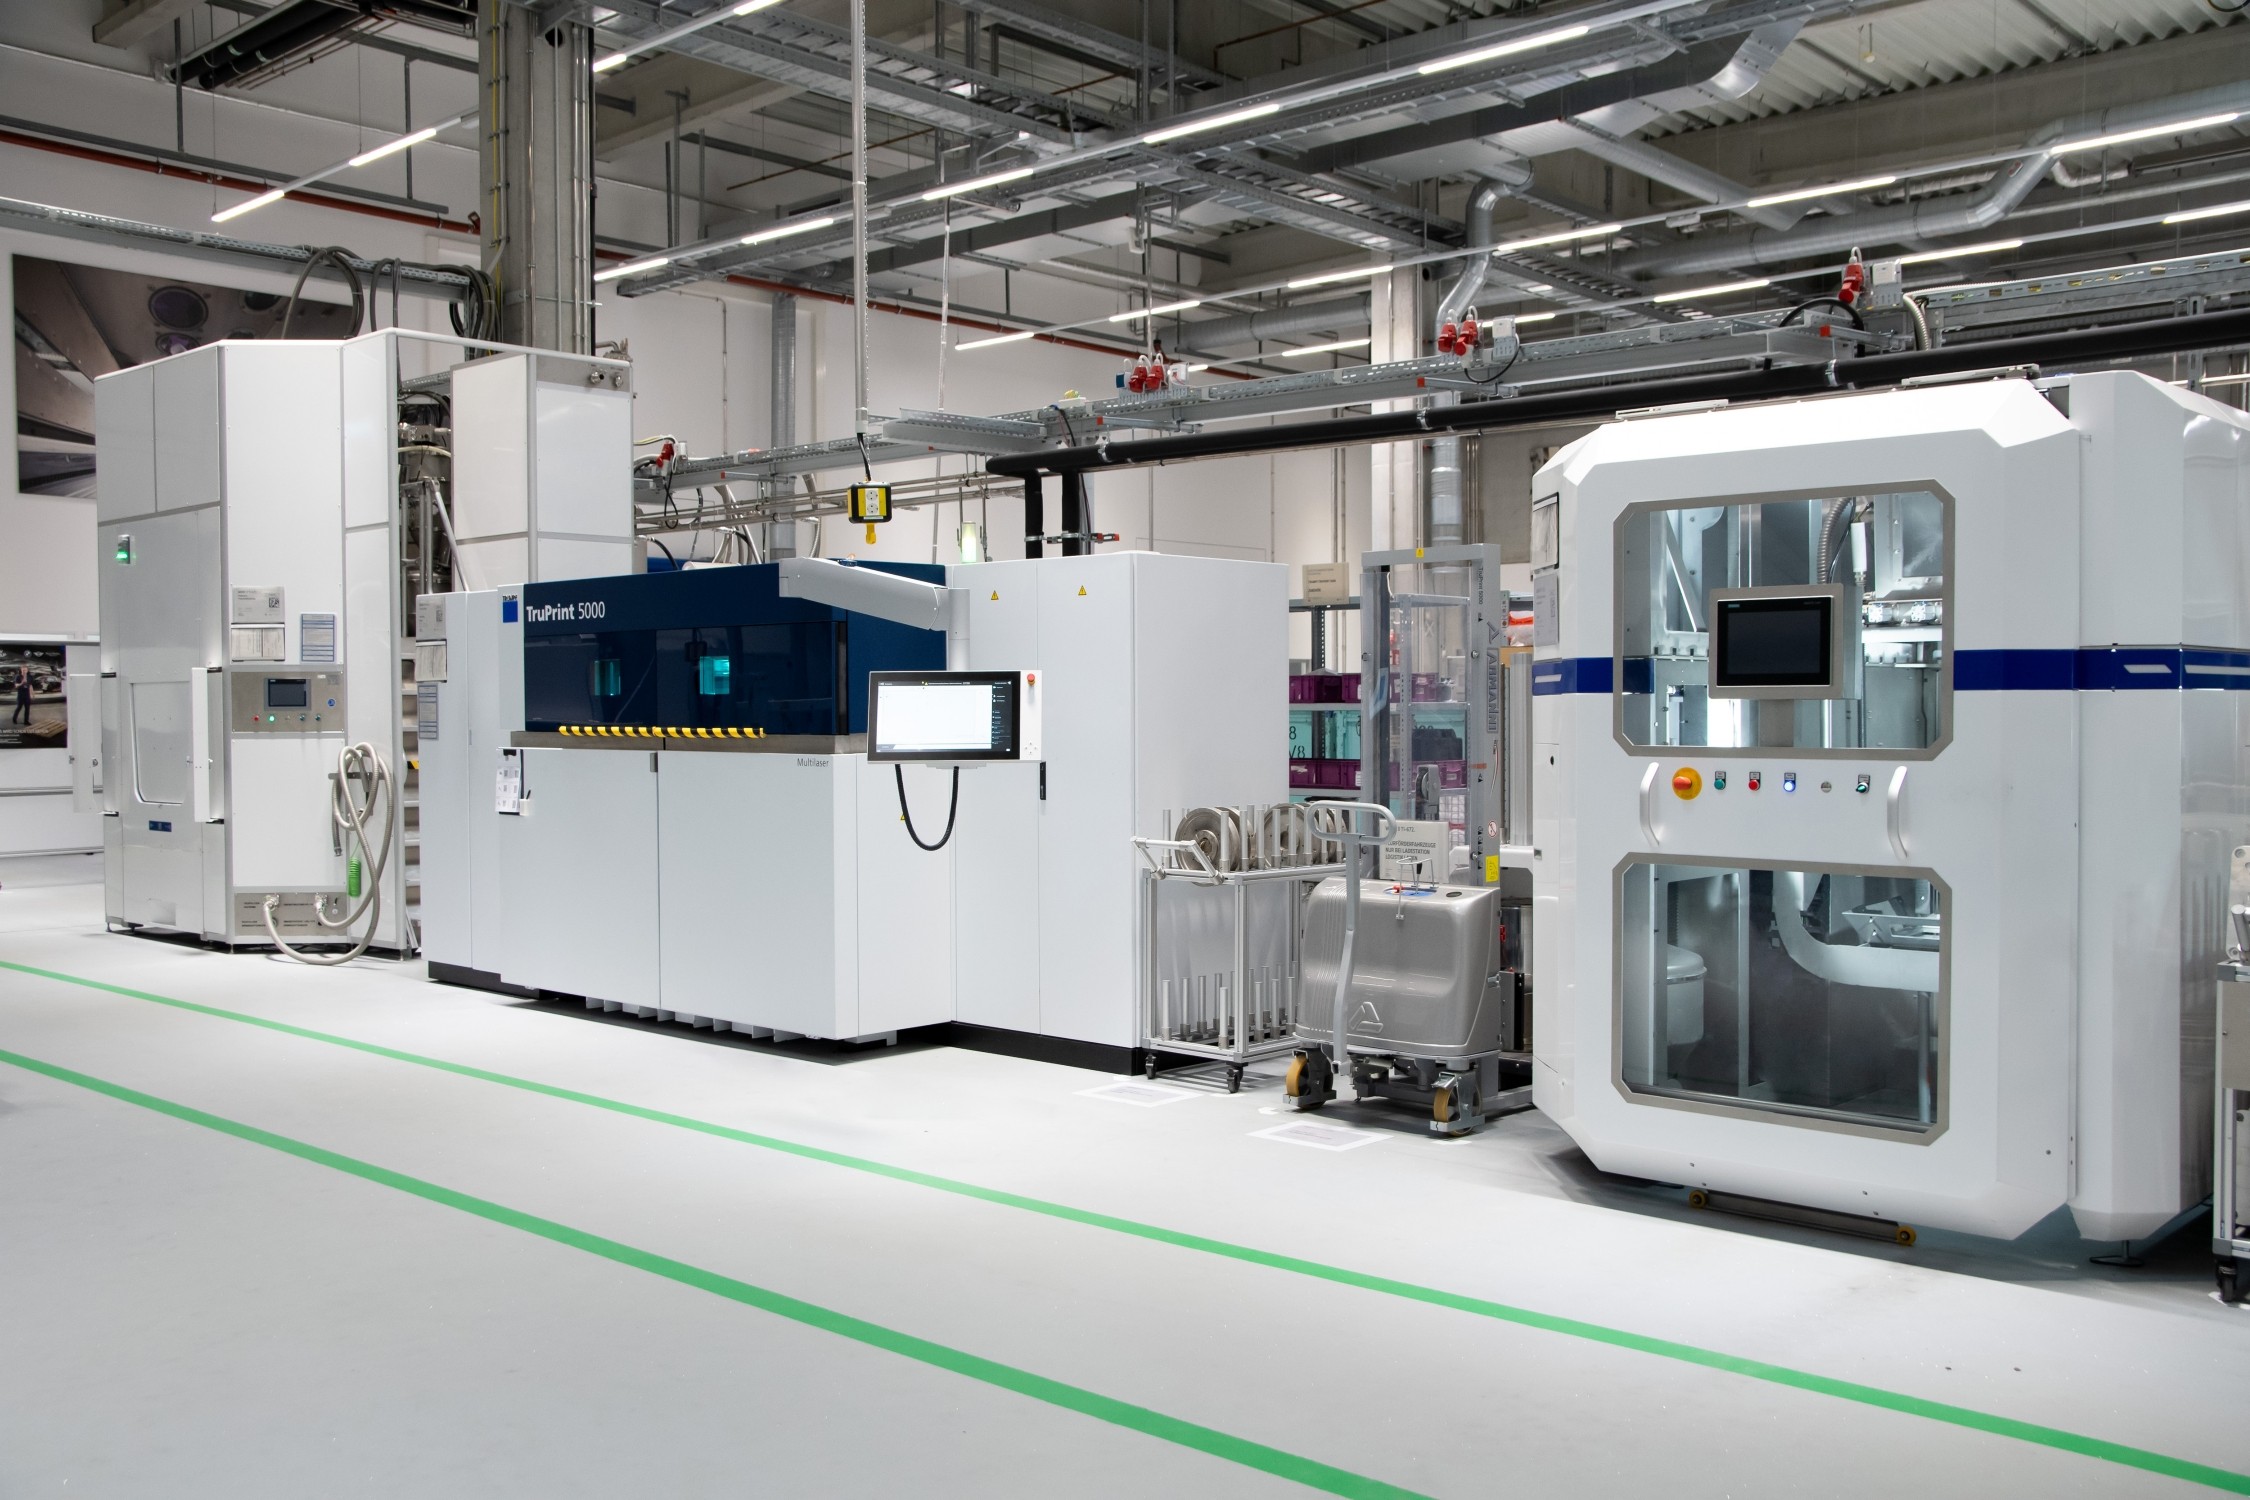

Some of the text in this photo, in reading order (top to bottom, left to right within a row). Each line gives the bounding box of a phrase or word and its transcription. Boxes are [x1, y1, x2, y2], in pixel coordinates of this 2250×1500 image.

[526, 601, 606, 622] TruPrint 5000
[797, 757, 830, 768] Multilaser
